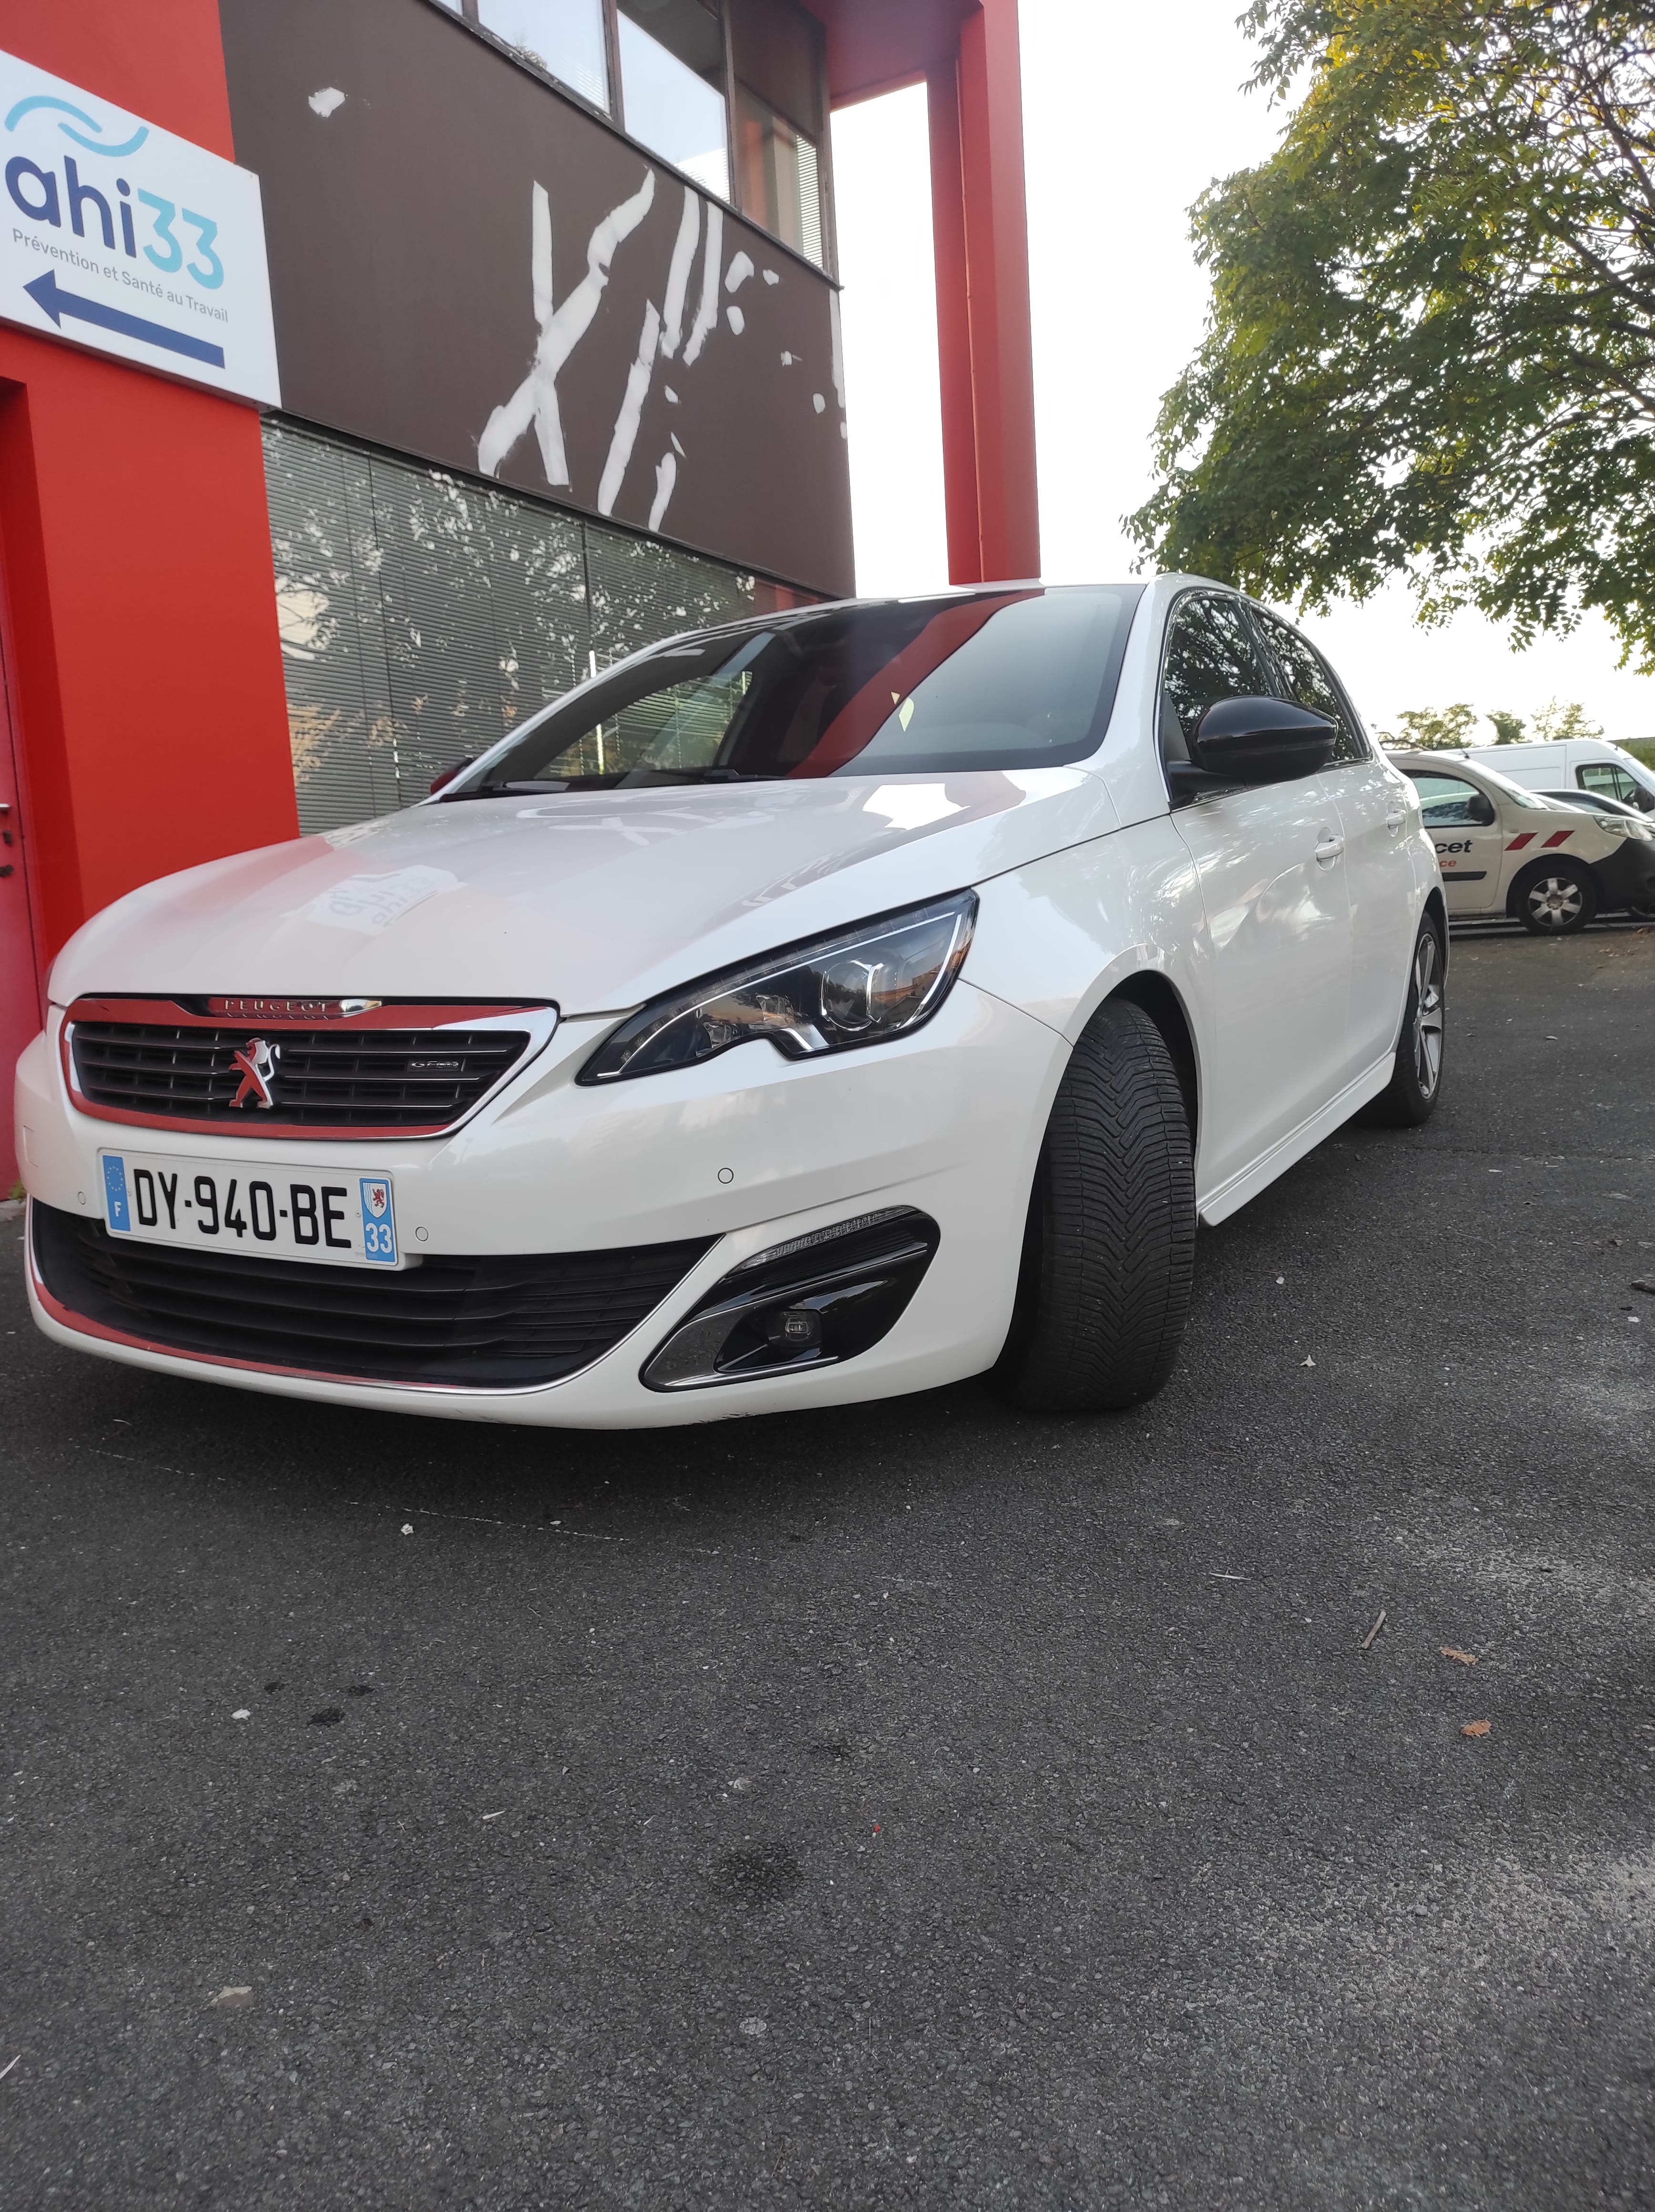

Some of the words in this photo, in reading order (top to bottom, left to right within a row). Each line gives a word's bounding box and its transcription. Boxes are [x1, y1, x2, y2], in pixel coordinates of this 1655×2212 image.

[5, 155, 224, 290] ahi33
[12, 228, 99, 274] Prévention
[103, 266, 118, 282] et
[122, 271, 163, 298] Santé
[167, 291, 183, 306] au
[186, 295, 229, 323] Travail
[225, 1000, 329, 1012] PEUGEOT
[114, 1200, 122, 1218] F
[365, 1222, 393, 1254] 33
